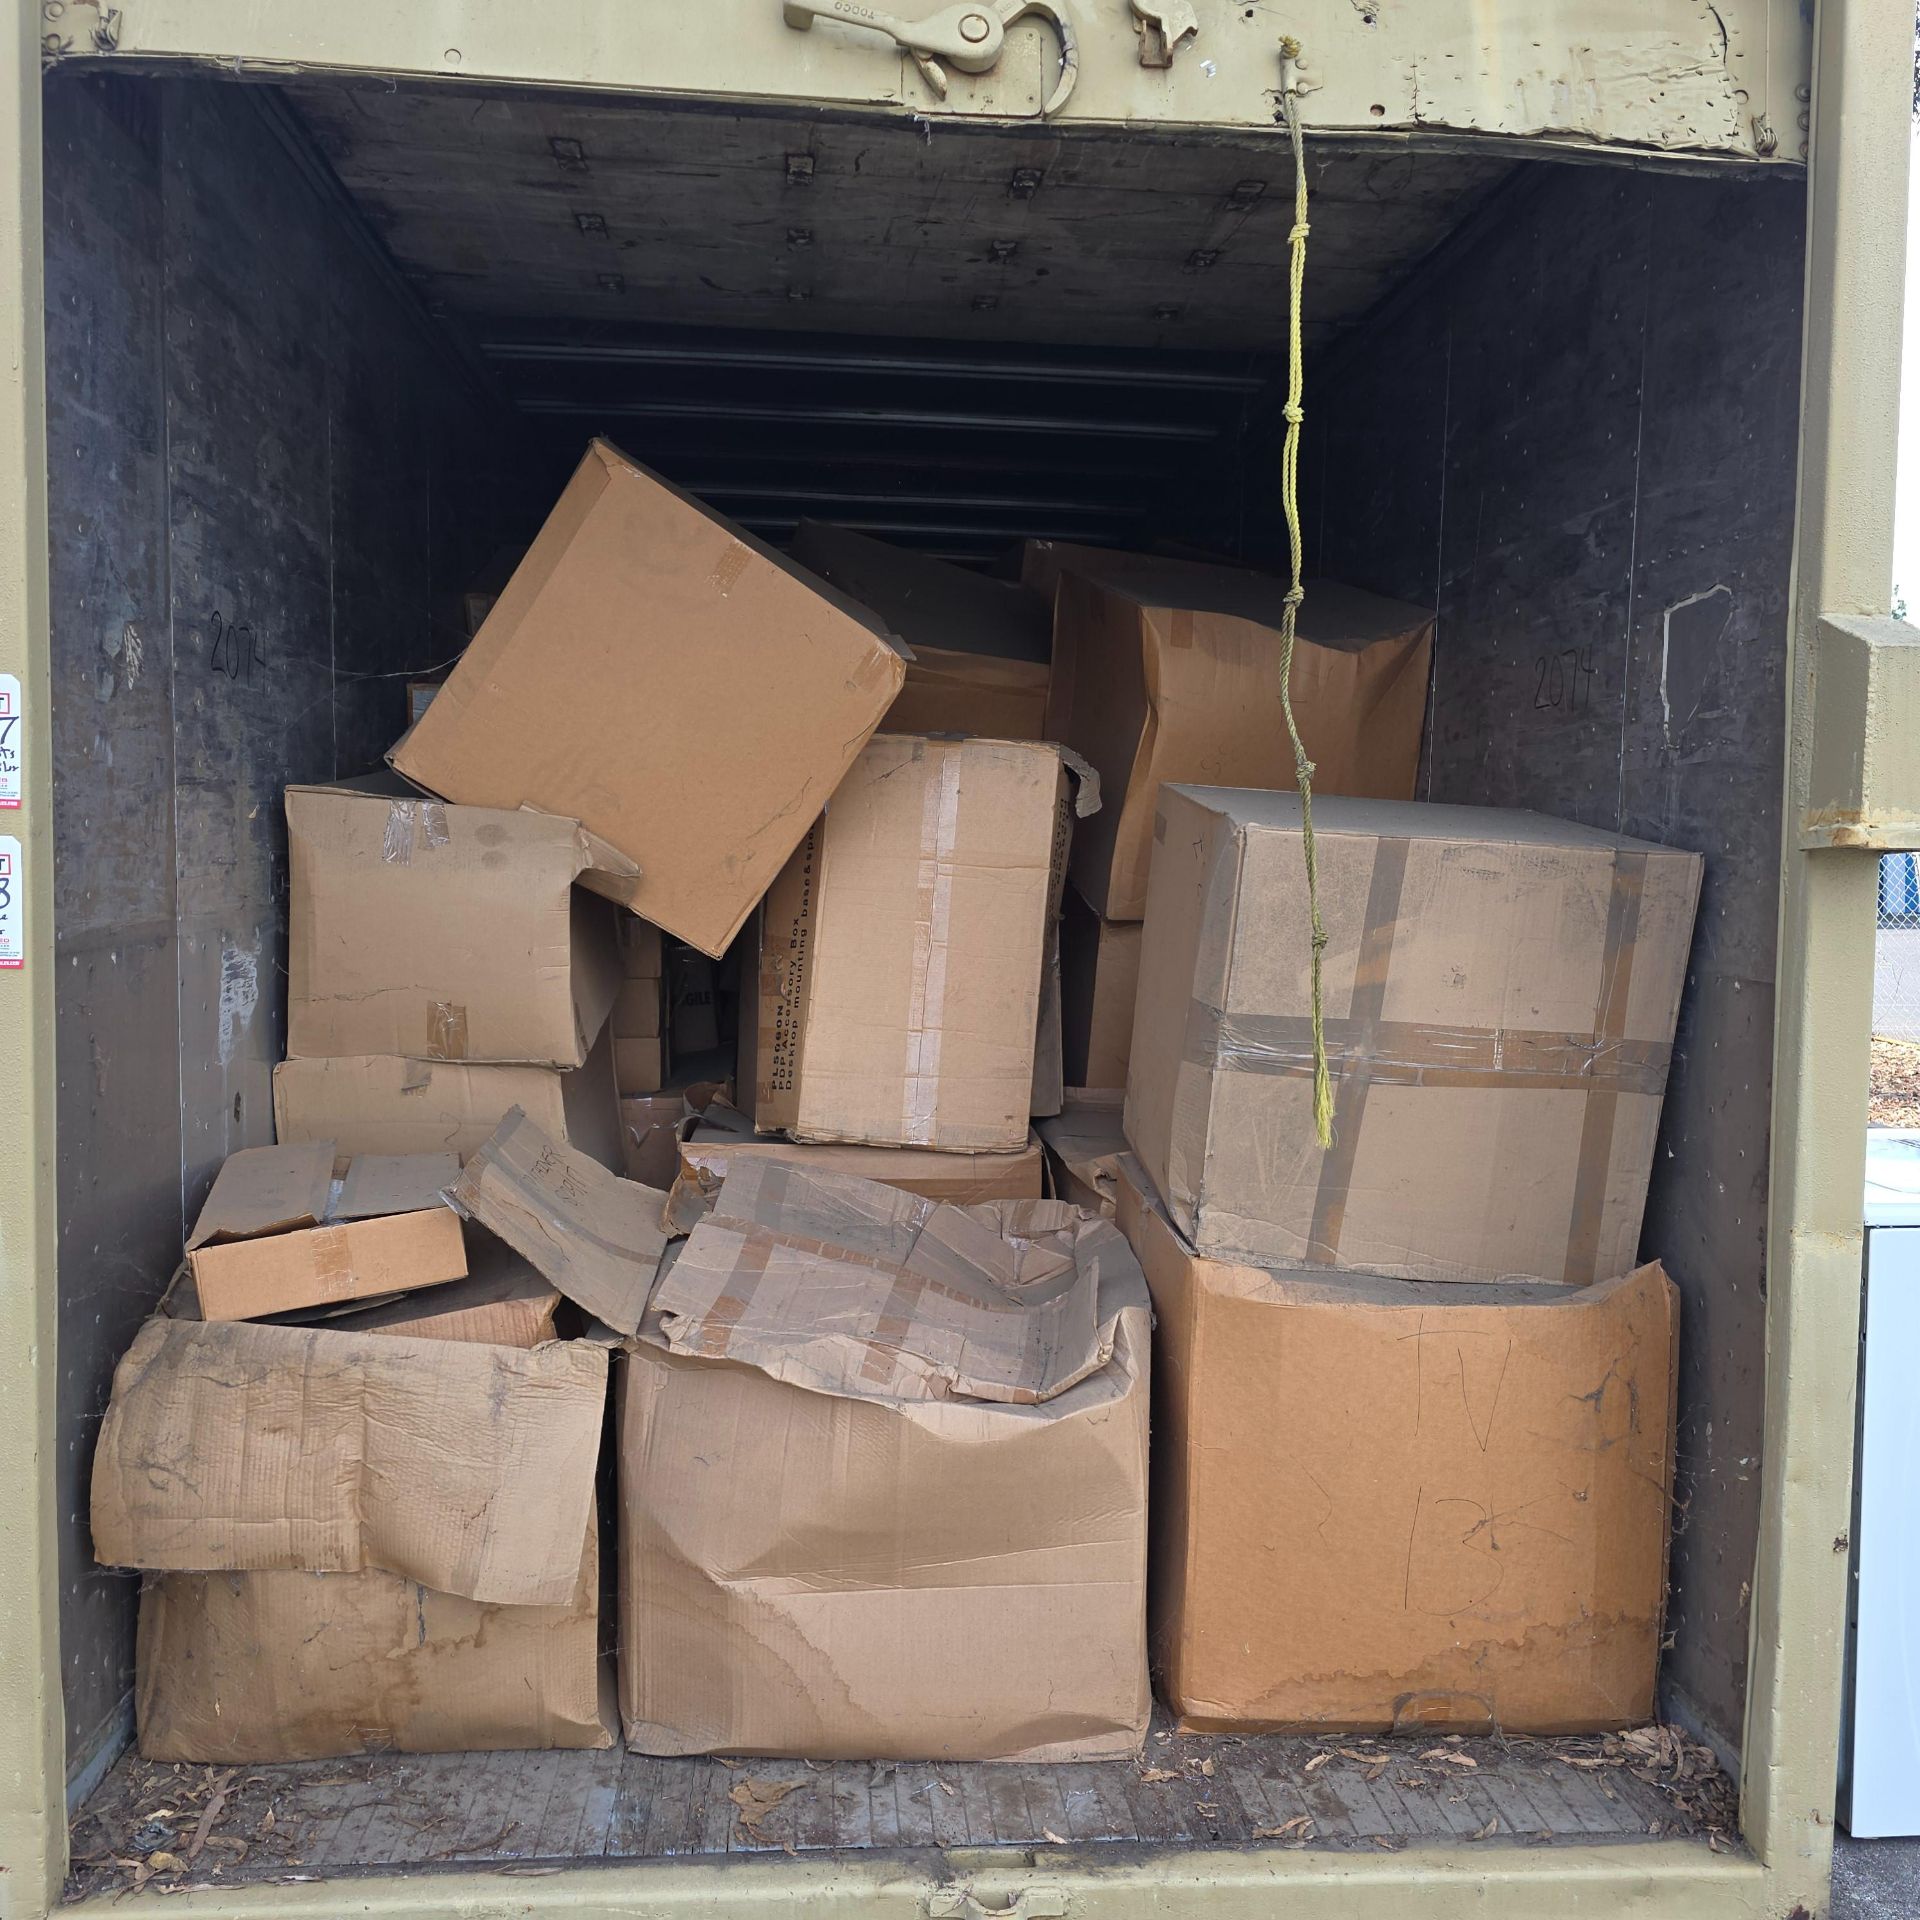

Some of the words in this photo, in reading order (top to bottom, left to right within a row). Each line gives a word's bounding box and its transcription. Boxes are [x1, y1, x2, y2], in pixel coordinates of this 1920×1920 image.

[1534, 642, 1597, 713] 2074
[683, 991, 712, 1006] GILE
[778, 1056, 786, 1090] PDP
[790, 918, 800, 949] Box
[785, 1020, 799, 1090] Desktop
[793, 928, 808, 1008] mounting
[1396, 1312, 1512, 1453] TV
